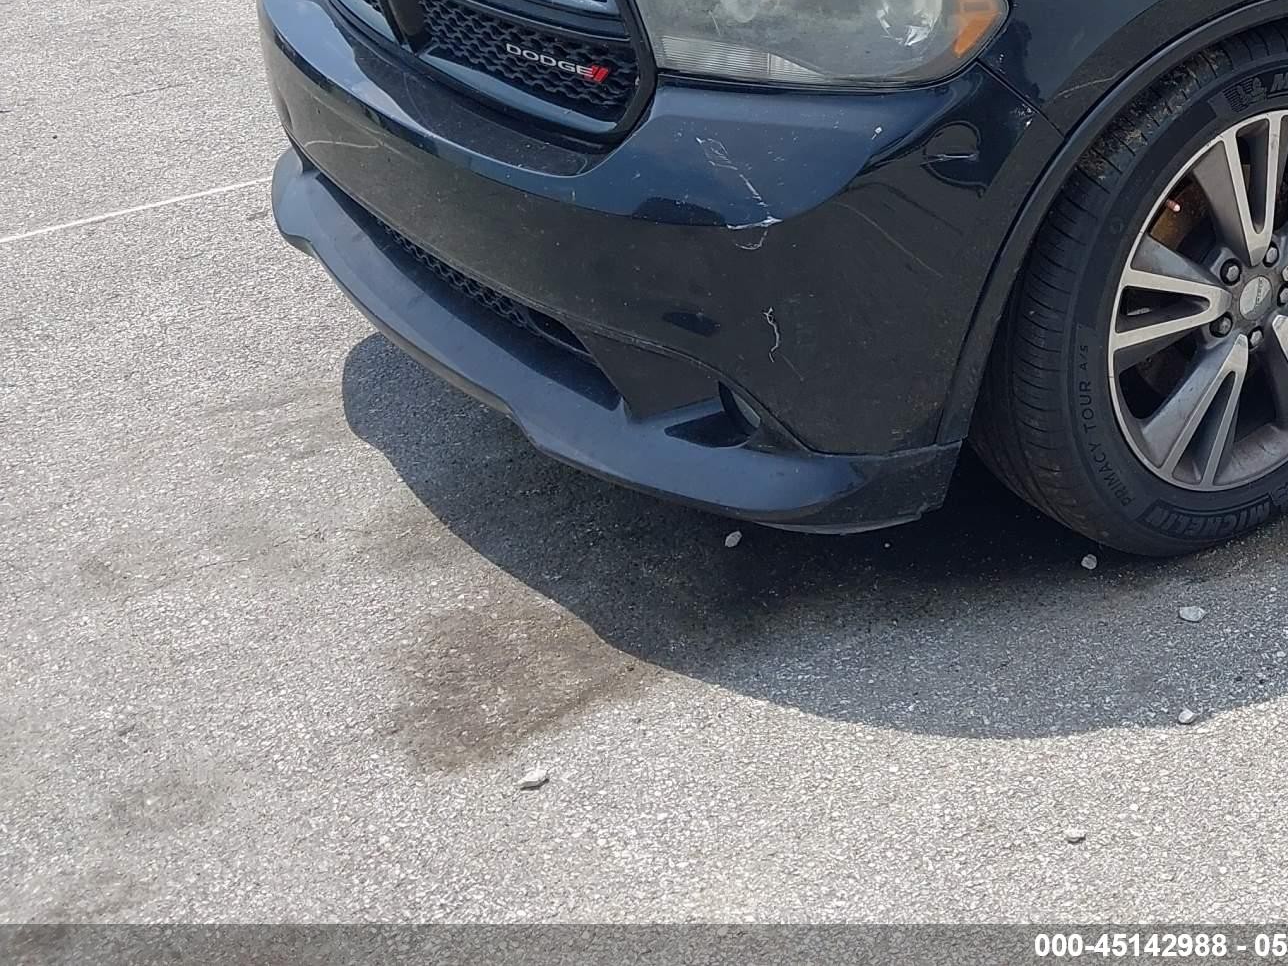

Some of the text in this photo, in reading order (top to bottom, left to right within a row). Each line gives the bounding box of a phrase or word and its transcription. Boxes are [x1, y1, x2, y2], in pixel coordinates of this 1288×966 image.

[505, 42, 595, 78] DODGE
[1079, 344, 1136, 507] PRIMACY TOUR A/S
